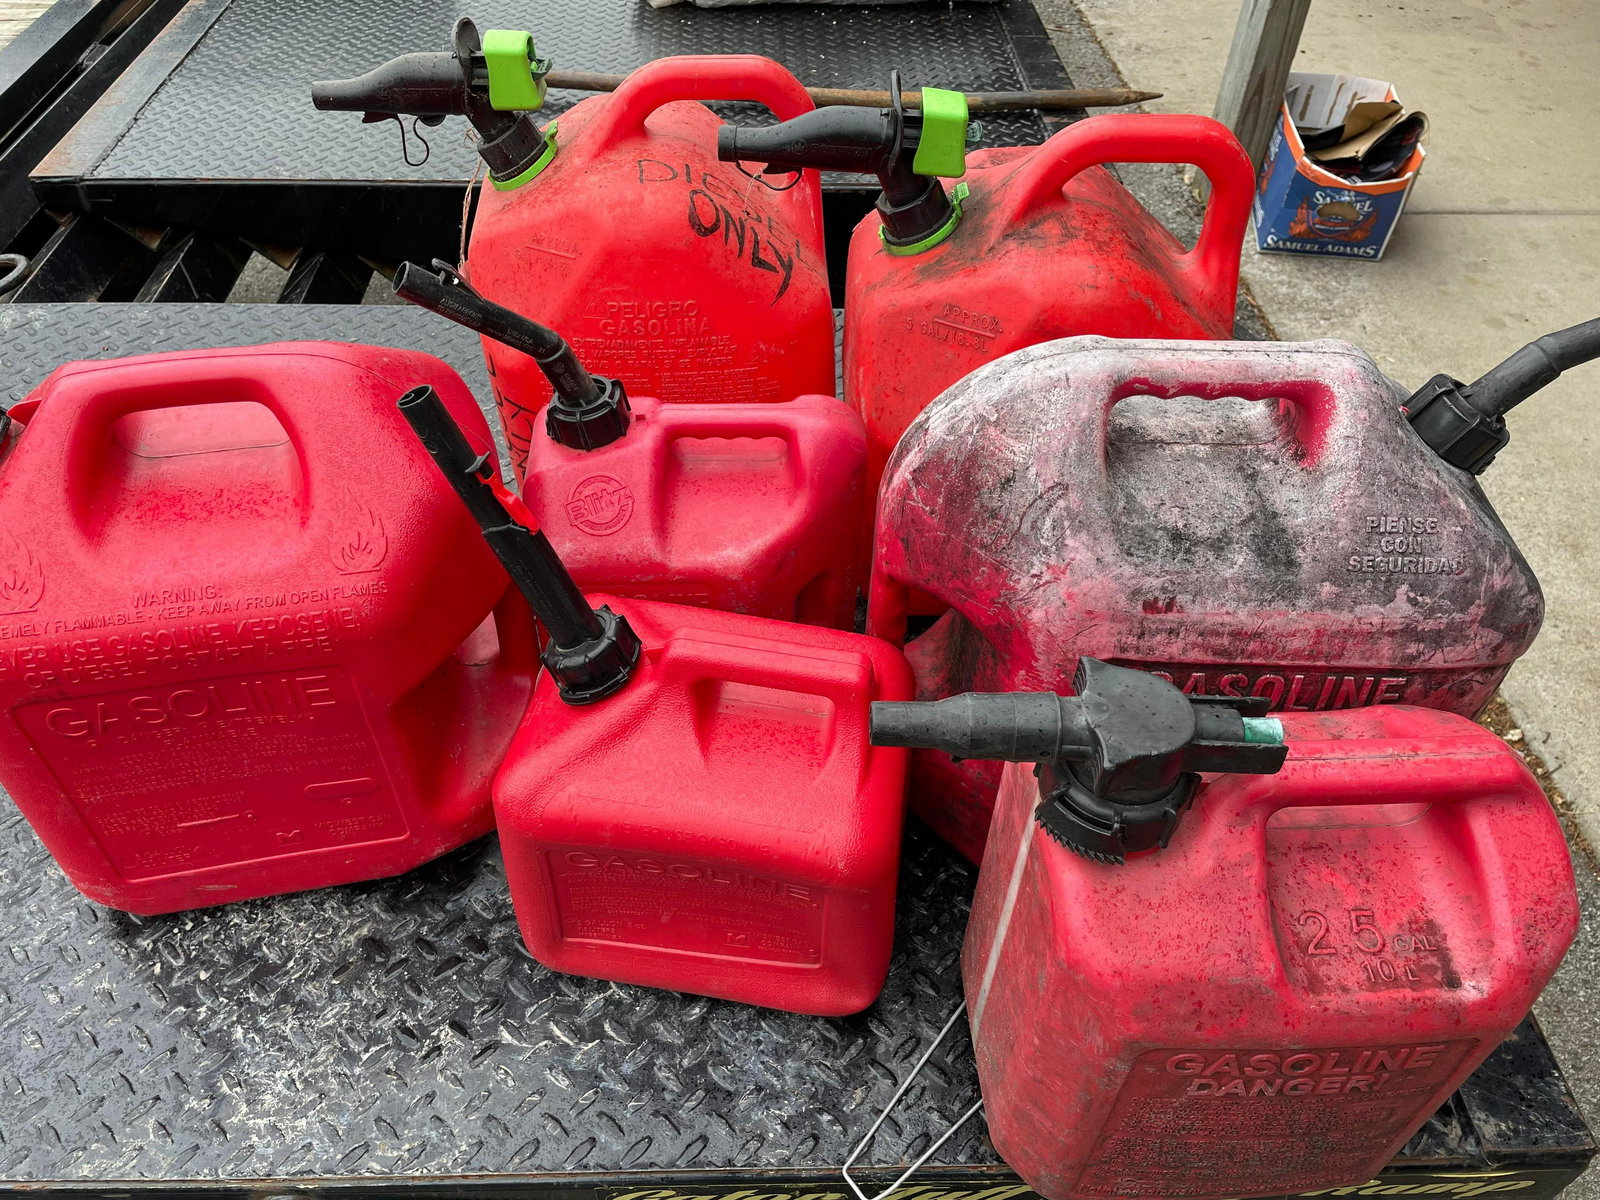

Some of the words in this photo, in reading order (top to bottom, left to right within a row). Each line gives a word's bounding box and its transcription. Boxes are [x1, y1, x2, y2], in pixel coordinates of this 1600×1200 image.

[688, 188, 793, 307] ONLY
[1263, 234, 1320, 251] SAMUEL
[1322, 242, 1377, 257] ADAMS
[606, 300, 699, 318] PELIGRO
[943, 305, 1004, 334] APPROX.
[600, 317, 710, 336] GASOLINA
[905, 317, 914, 331] 5
[572, 337, 664, 349] EXTREMADAMENTE
[668, 335, 731, 347] INFLAMABLE
[592, 349, 637, 359] VAPORES
[581, 359, 613, 369] OCIVO
[628, 359, 660, 369] FATAL
[678, 358, 692, 368] SE
[563, 485, 635, 526] Blitz
[1365, 515, 1439, 534] PIENSE
[1380, 536, 1422, 554] CON
[1348, 555, 1467, 576] SEGURIDAD
[132, 584, 223, 608] WARNING:
[0, 622, 49, 640] EMELY
[55, 611, 144, 634] FLAMMABLE
[157, 603, 195, 621] KEEP
[199, 599, 240, 615] AWAY
[245, 593, 286, 610] FROM
[290, 588, 329, 605] OPEN
[333, 580, 388, 600] FLAMES
[24, 670, 56, 688] OR
[62, 659, 147, 684] DIESEL
[146, 654, 179, 673] TO
[184, 644, 254, 669] START
[280, 635, 333, 657] FIRE
[54, 638, 105, 663] USE
[45, 675, 337, 738] GASOLINE
[564, 851, 811, 901] GASOLINE
[1298, 908, 1386, 955] 2.5
[1393, 935, 1437, 951] GAL
[1360, 957, 1395, 983] 10
[1405, 966, 1420, 981] L
[1165, 1044, 1446, 1077] GASOLINE
[1187, 1072, 1391, 1098] DANGER!
